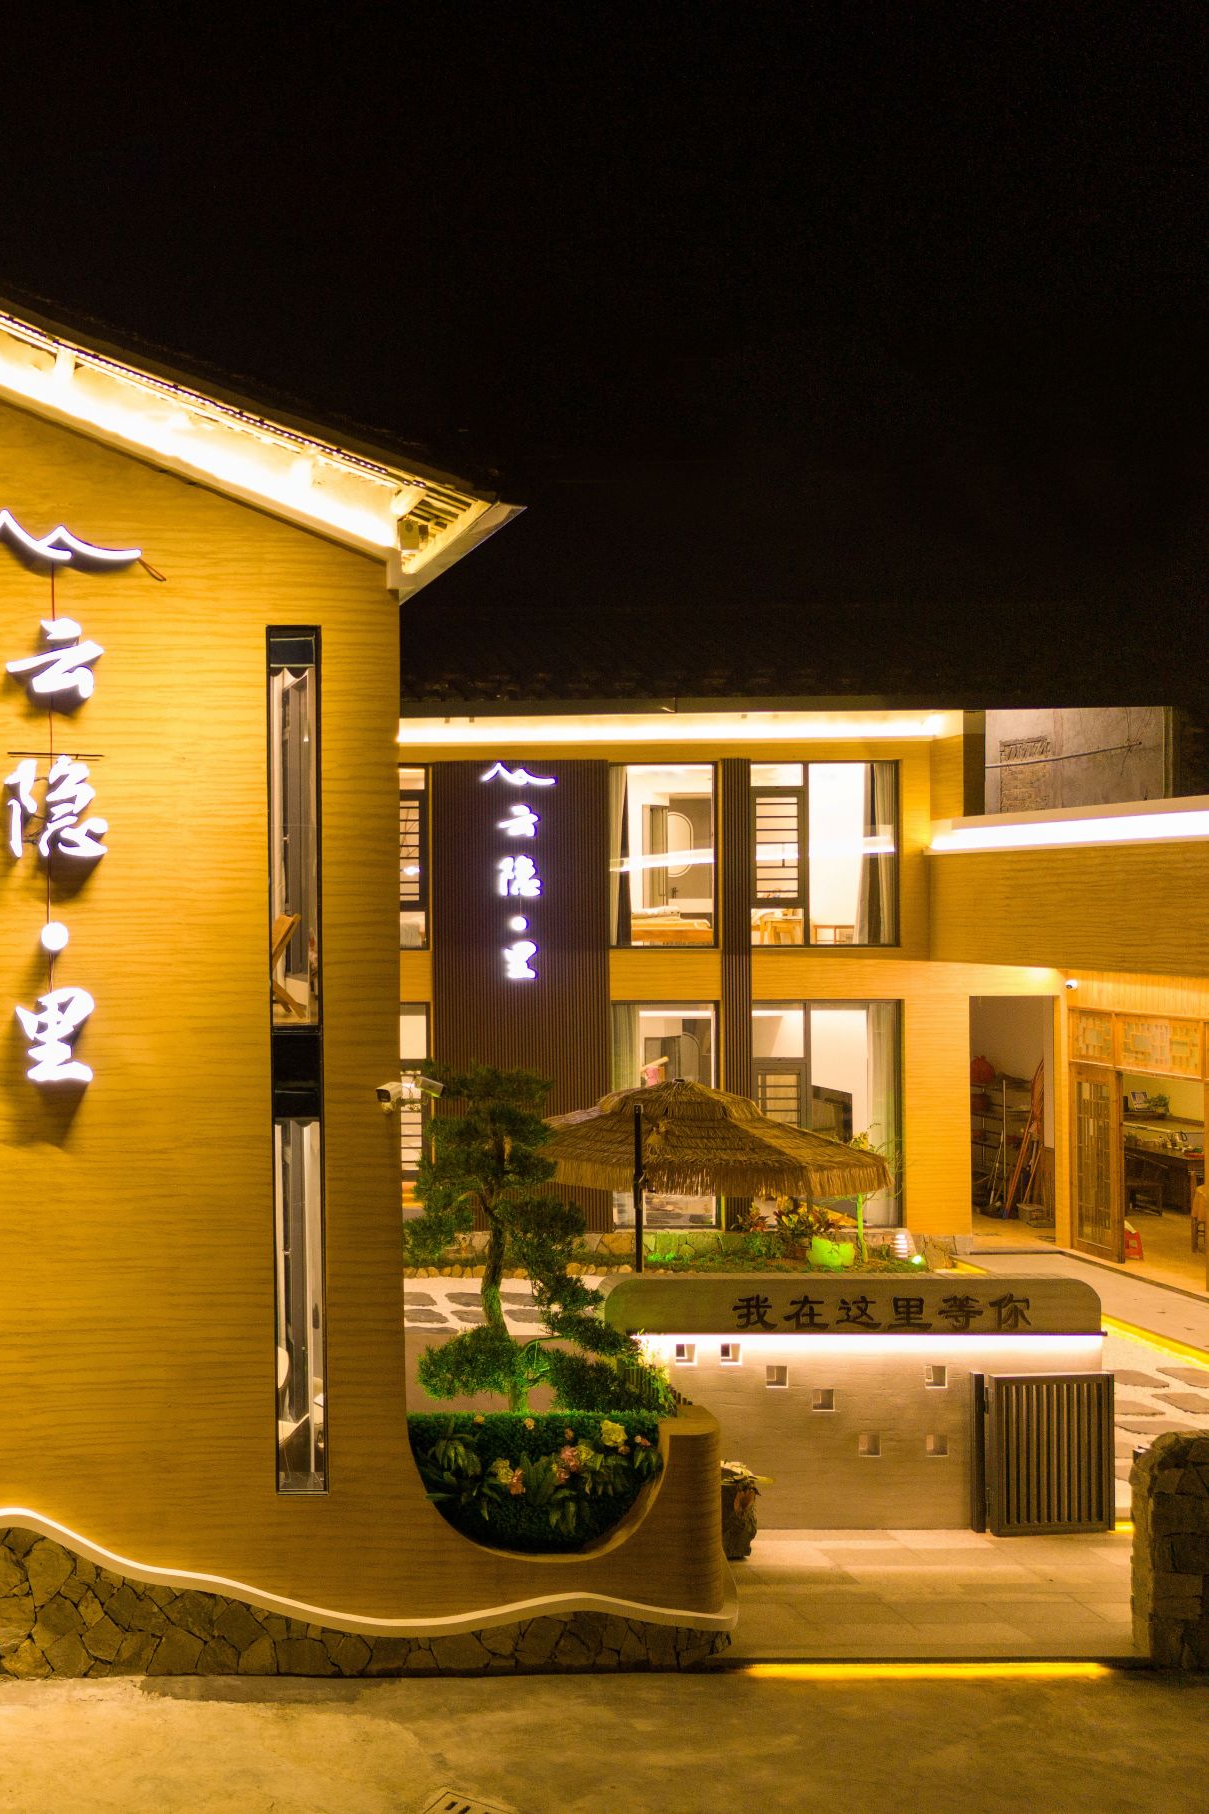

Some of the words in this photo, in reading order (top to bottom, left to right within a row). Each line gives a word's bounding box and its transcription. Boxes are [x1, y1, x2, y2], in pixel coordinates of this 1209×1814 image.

[731, 1293, 1032, 1330] 我在这里等你
